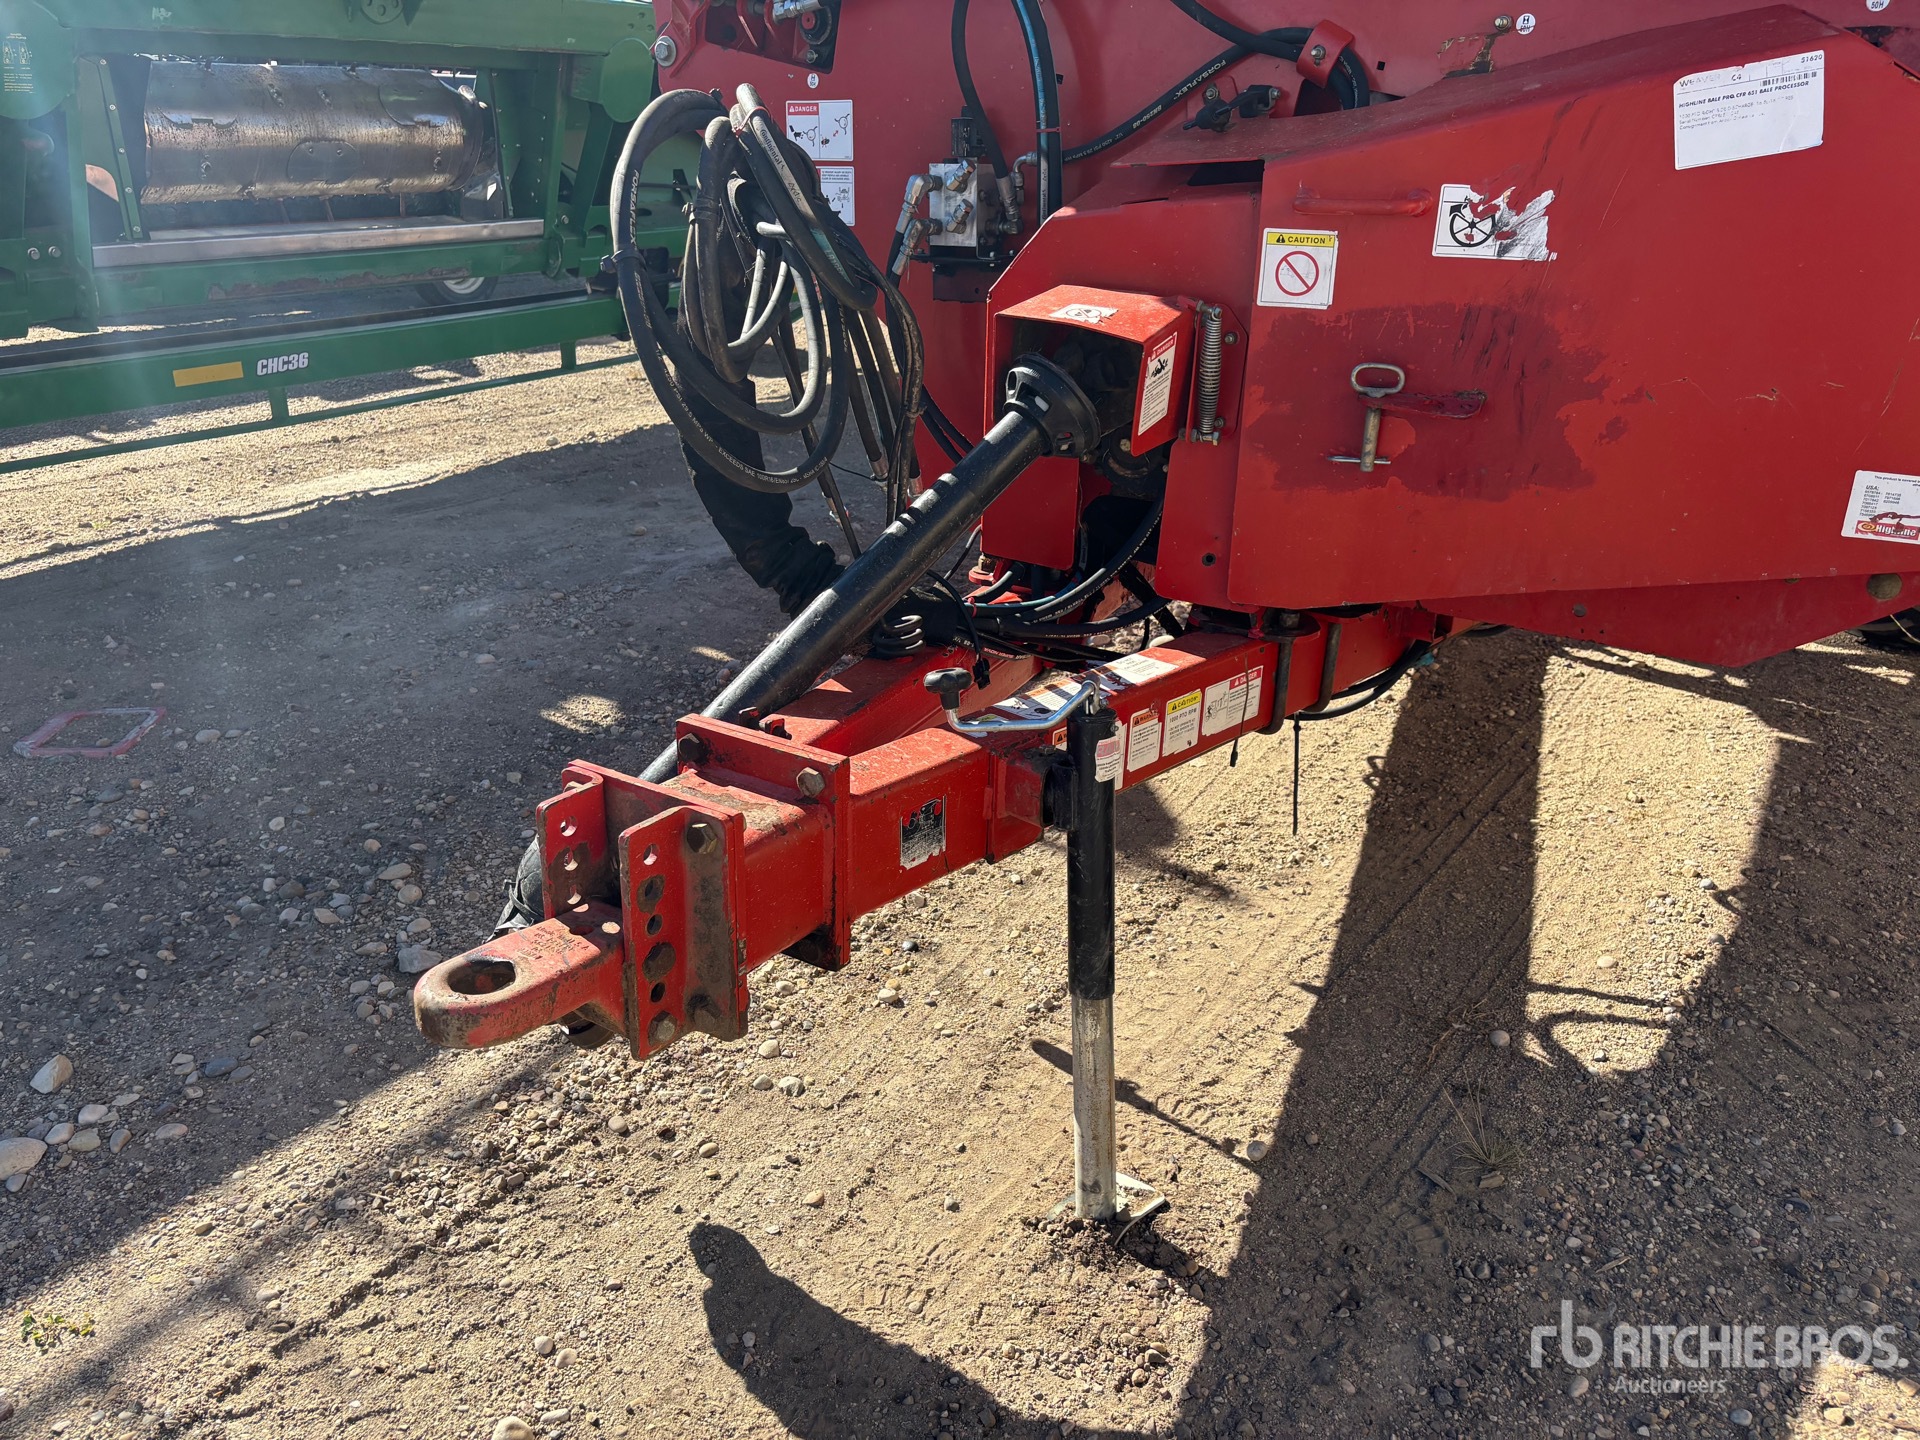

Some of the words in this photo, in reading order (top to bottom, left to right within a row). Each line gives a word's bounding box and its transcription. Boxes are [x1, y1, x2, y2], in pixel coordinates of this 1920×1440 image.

[1175, 59, 1227, 98] FORSAFLEX
[1679, 100, 1706, 109] HIGHLINE
[1759, 86, 1773, 94] BALE
[1774, 80, 1809, 92] PROCESSOR
[629, 169, 640, 245] FORSAFLEX
[1287, 236, 1326, 244] CAUTION
[256, 352, 309, 376] CHC36
[718, 446, 744, 471] EXCEEDS
[744, 465, 756, 477] SAE
[1238, 671, 1258, 685] DAGER
[1177, 695, 1199, 708] CAUTION
